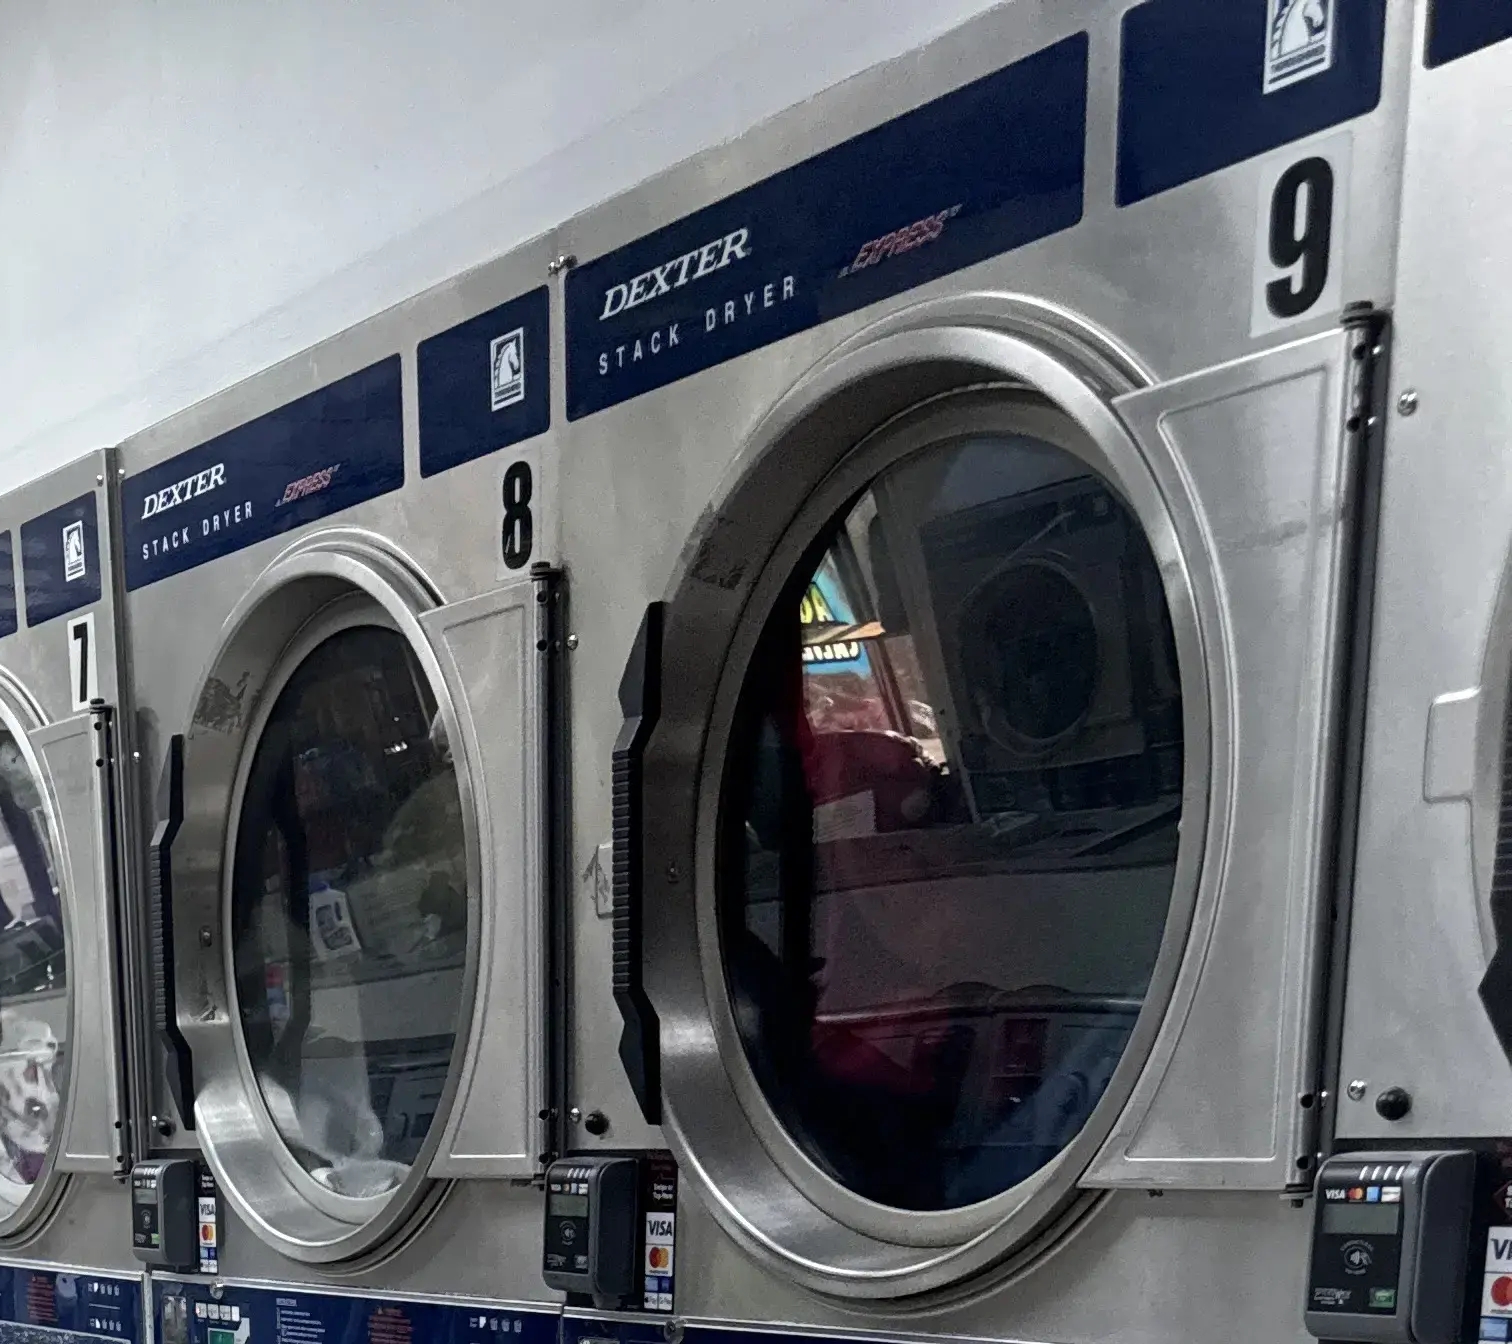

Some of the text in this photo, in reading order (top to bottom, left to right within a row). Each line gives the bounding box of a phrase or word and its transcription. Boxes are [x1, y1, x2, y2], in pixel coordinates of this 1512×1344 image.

[849, 209, 948, 272] EXPRESS
[1266, 156, 1334, 319] 9
[599, 227, 749, 321] DEXTER
[599, 275, 796, 376] STACK DRYER
[141, 462, 226, 520] DEXTER
[501, 460, 534, 570] 8
[142, 500, 253, 561] STACK DRYER
[71, 621, 90, 703] 7
[647, 1220, 673, 1236] VISA
[1325, 1188, 1346, 1200] VISA
